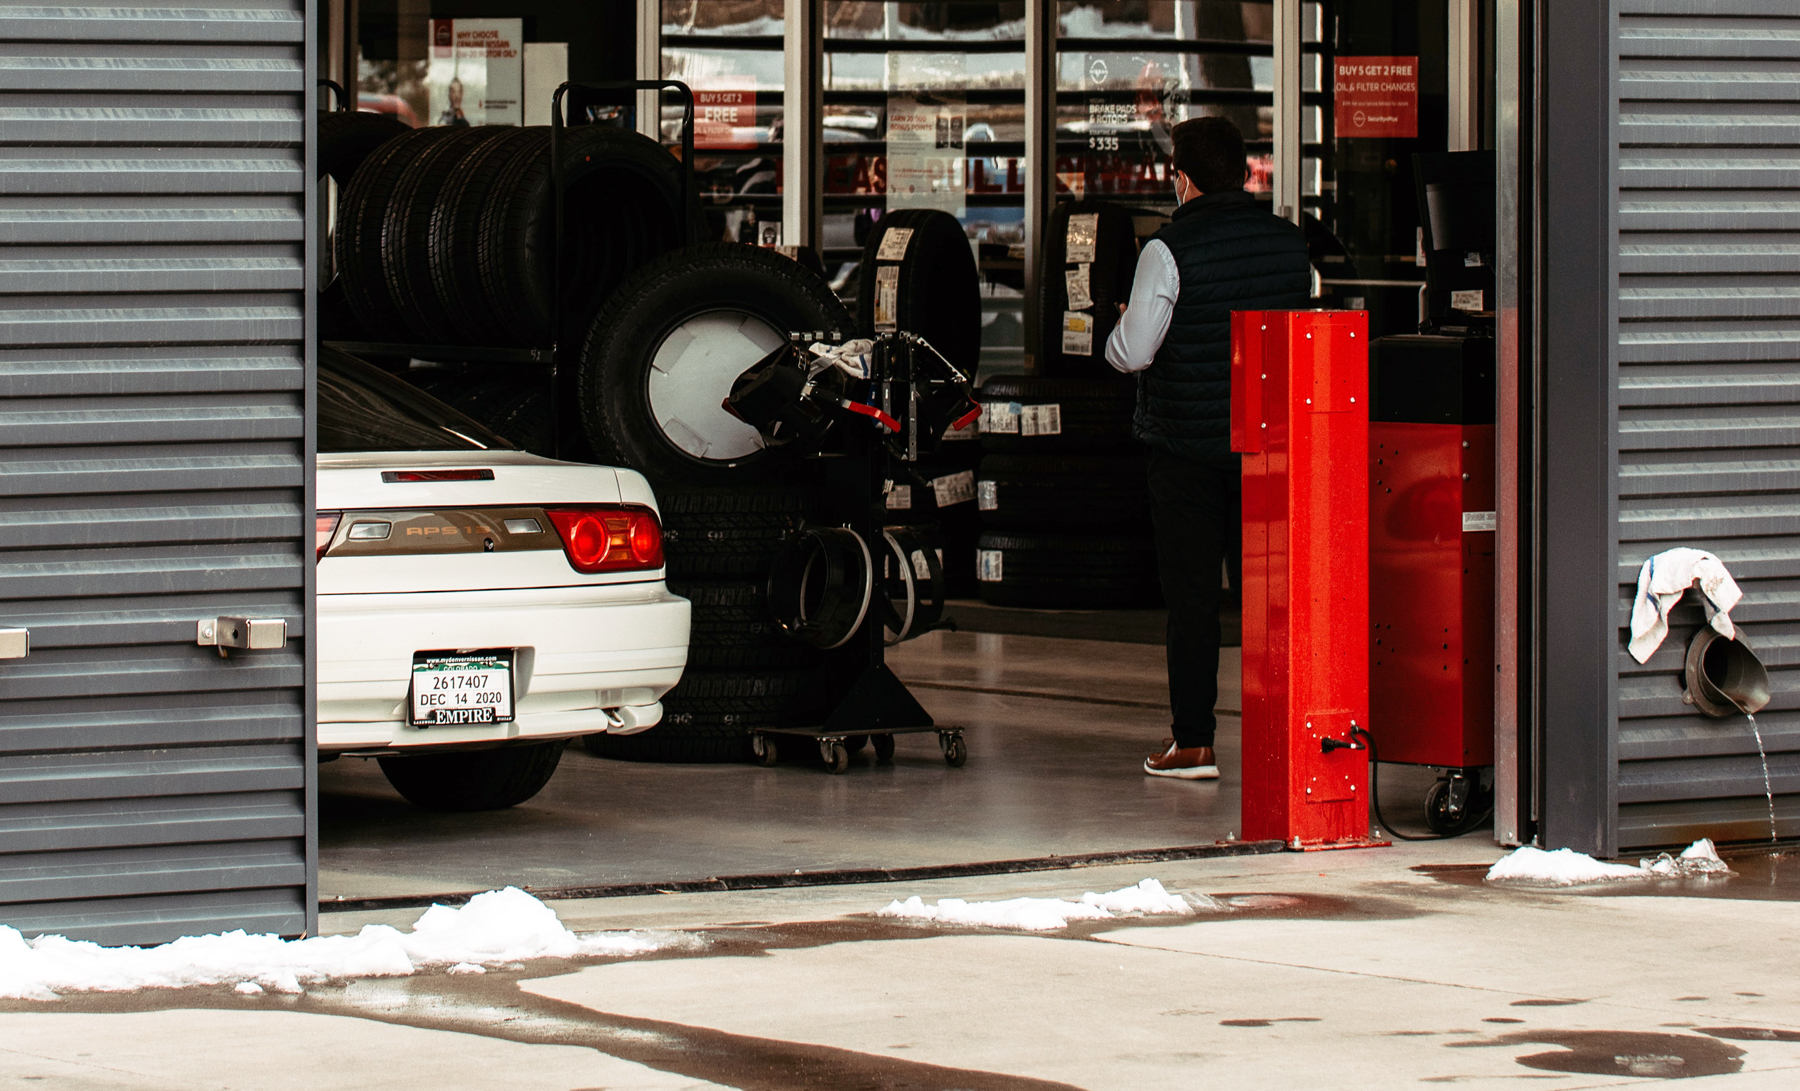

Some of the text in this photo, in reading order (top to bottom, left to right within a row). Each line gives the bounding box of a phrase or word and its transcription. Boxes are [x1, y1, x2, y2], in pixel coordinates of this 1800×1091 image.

[457, 31, 471, 39] WHY
[472, 30, 499, 39] CHOOSE
[485, 40, 510, 48] NISSAN
[479, 50, 501, 58] MOTOR
[502, 49, 517, 57] OIL?
[1339, 65, 1412, 76] BUY 5 GET 2 FREE
[1336, 82, 1416, 93] OIL & FILTER CHANGES
[700, 93, 742, 103] BUY 5 GET 2
[704, 106, 738, 123] FREE
[1089, 105, 1137, 114] BRAKE PADS
[1089, 115, 1128, 124] & ROTORS
[890, 123, 933, 131] BONUS POINTS
[1089, 137, 1119, 151] $335
[426, 655, 497, 665] www.mydenvernissan.com
[433, 674, 489, 690] 2617407
[420, 691, 502, 706] DEC 14 2020
[435, 707, 493, 725] EMPIRE
